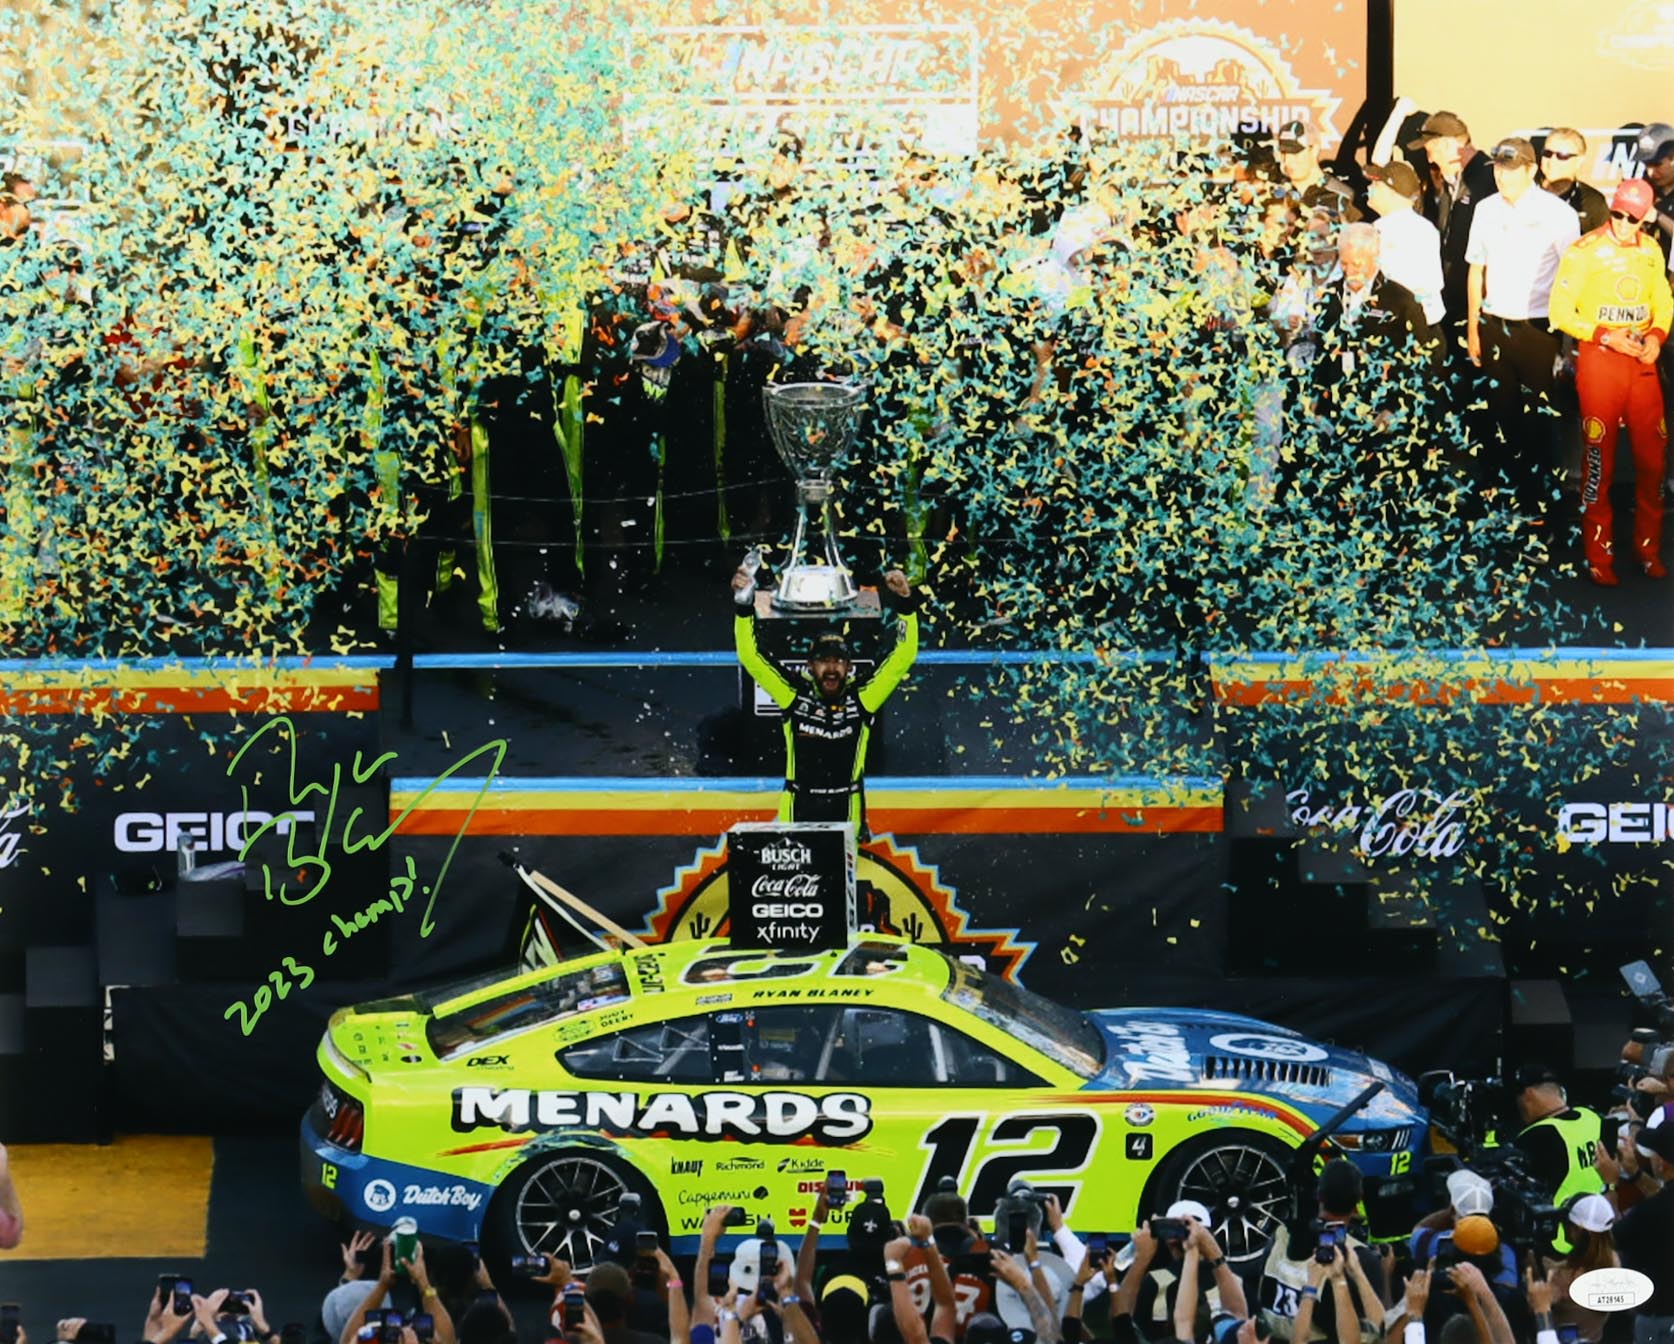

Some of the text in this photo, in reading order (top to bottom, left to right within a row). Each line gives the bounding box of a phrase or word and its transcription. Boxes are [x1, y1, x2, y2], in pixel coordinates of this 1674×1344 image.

[1172, 86, 1240, 103] NASCAR
[799, 722, 853, 739] MENARDS
[1558, 802, 1674, 843] GEI
[761, 848, 812, 864] BUSCH
[751, 903, 824, 919] GEICO
[756, 921, 822, 944] xfinity
[225, 957, 315, 1037] 2023
[753, 988, 875, 999] RYAN BLANEY
[467, 1055, 511, 1067] DEX
[454, 1086, 872, 1144] MENARDS
[671, 1157, 704, 1178] KNAUF
[716, 1160, 765, 1171] Richmond
[791, 1158, 825, 1169] Kidde
[908, 1110, 1100, 1226] 12
[1389, 1152, 1411, 1175] 12
[322, 1163, 338, 1189] 12
[402, 1184, 481, 1212] Dutch Boy
[678, 1190, 750, 1206] Capgemini
